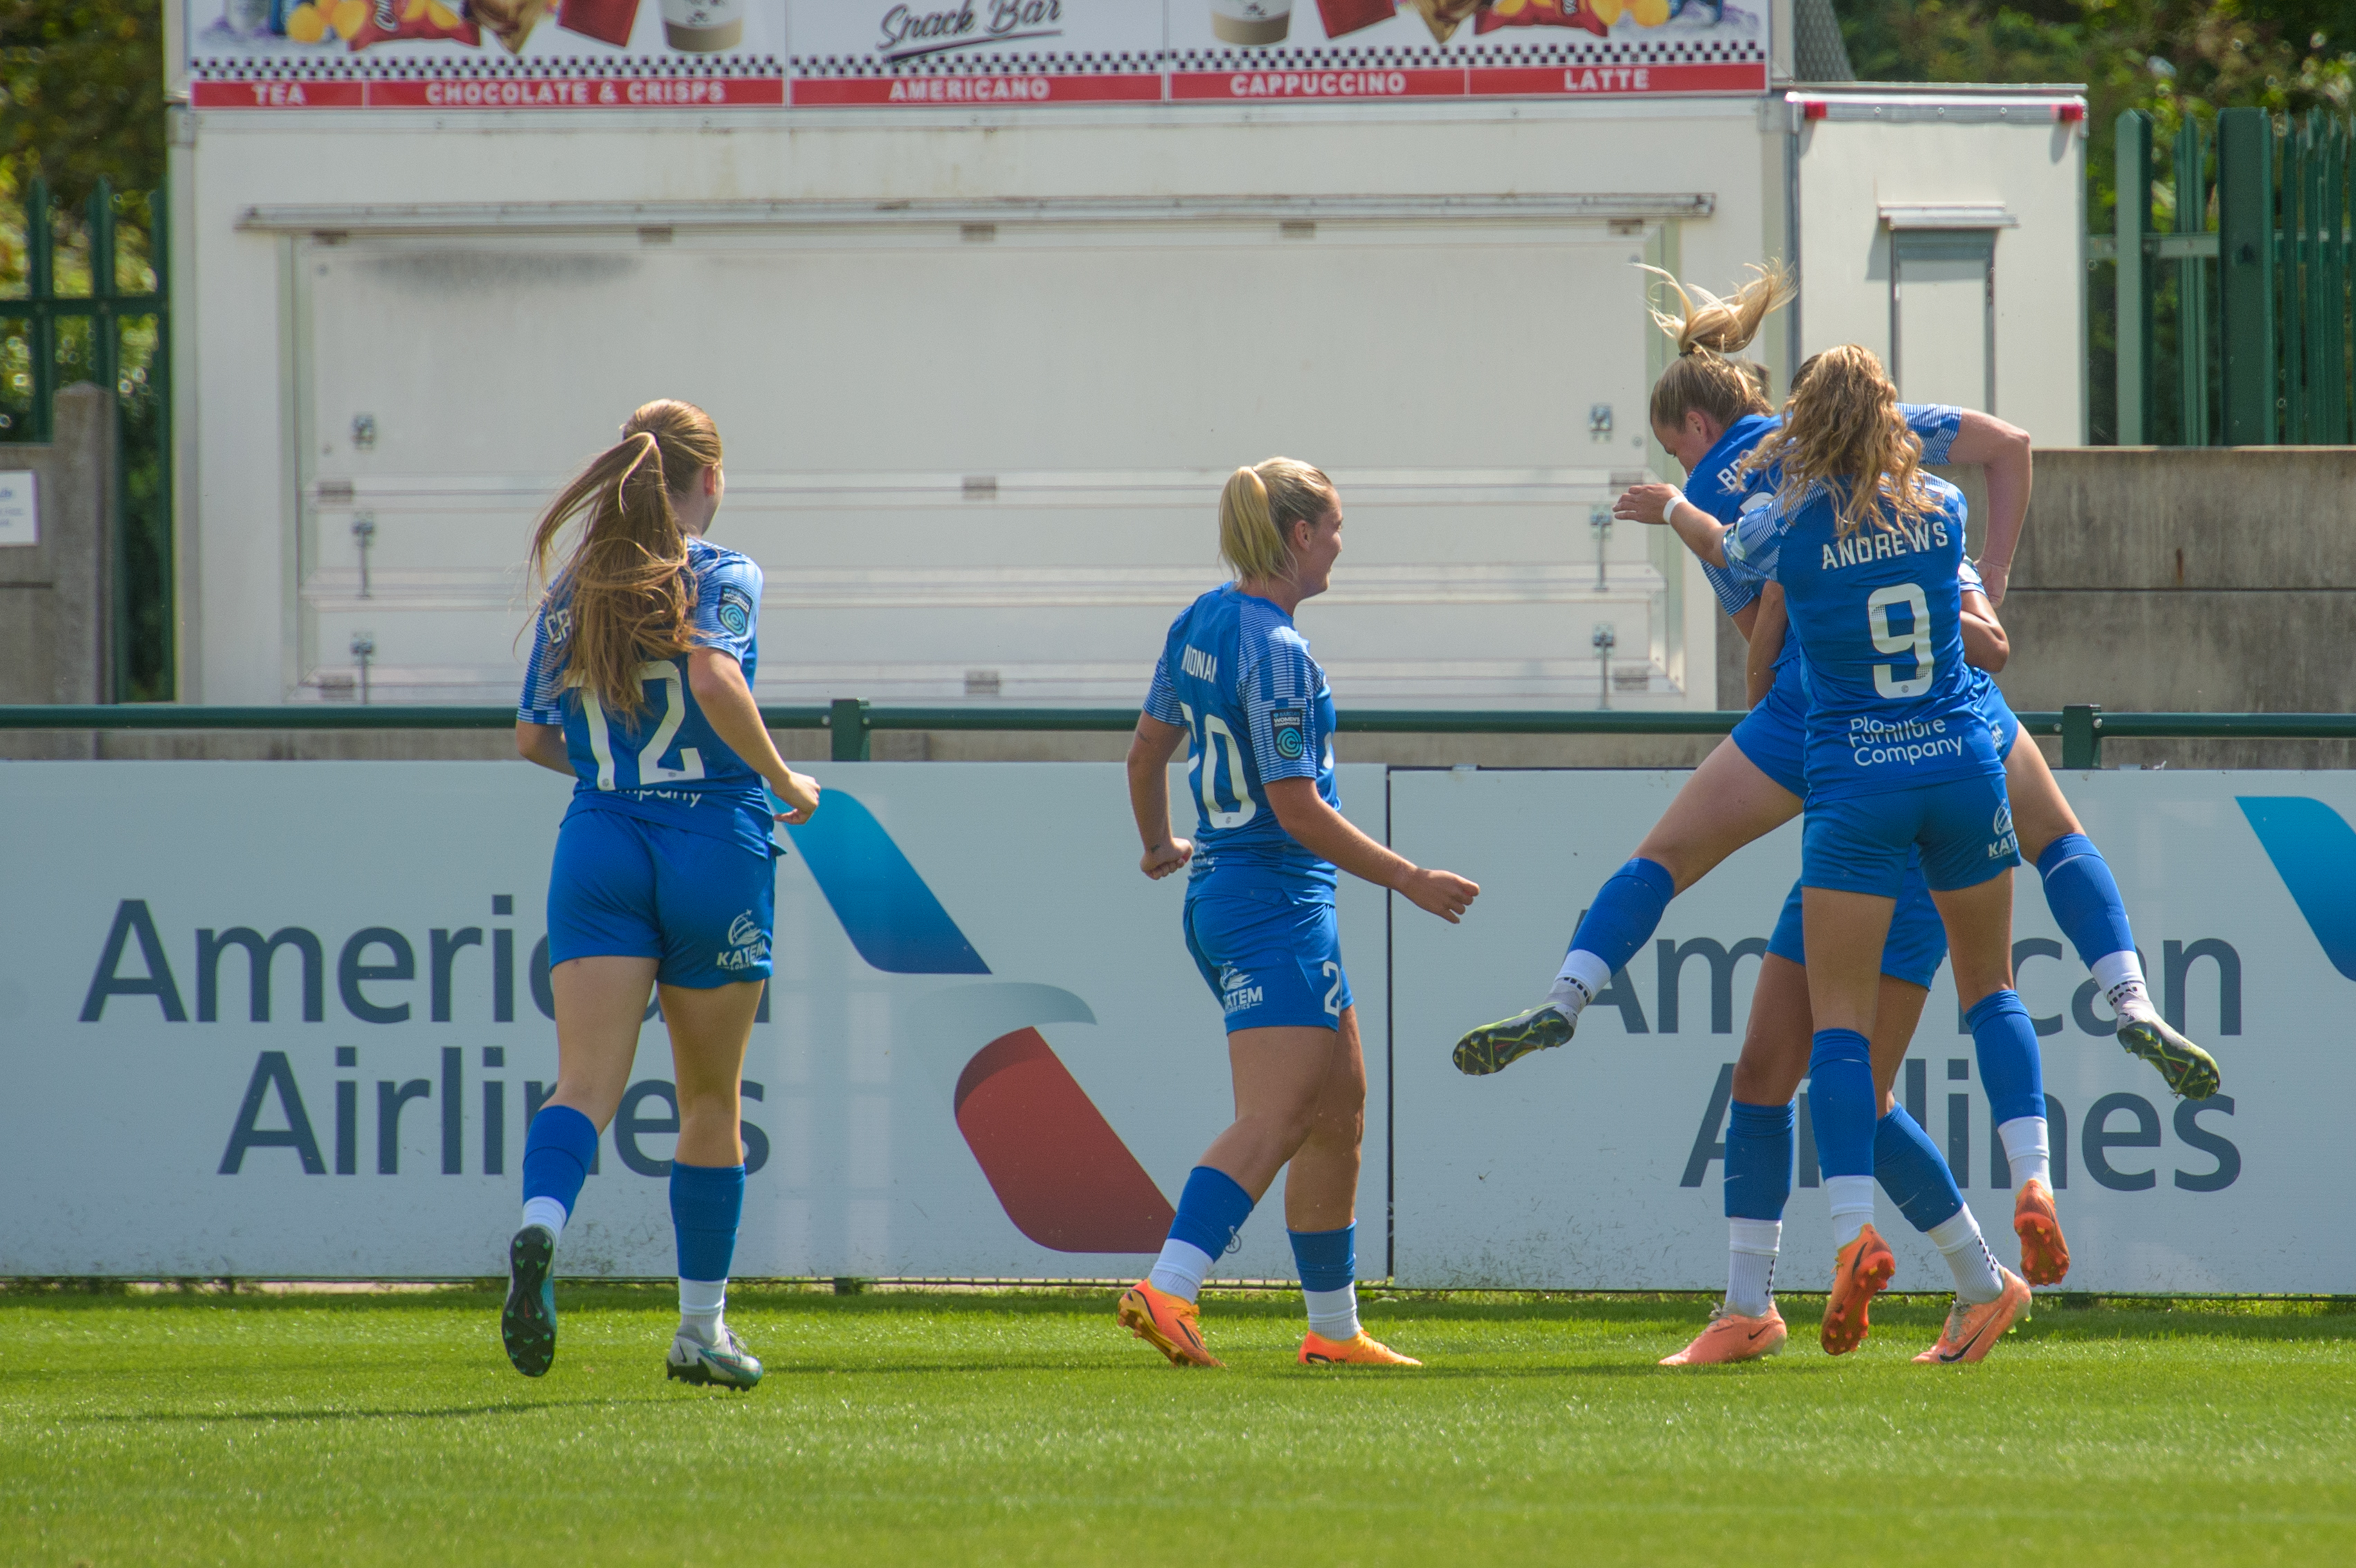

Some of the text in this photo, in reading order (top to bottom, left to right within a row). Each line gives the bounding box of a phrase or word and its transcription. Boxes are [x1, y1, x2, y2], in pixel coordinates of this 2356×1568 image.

[876, 0, 1062, 49] Snack Bar
[425, 80, 726, 105] CHOCOLATE & CRISPS
[888, 78, 1051, 102] AMERICANO
[1229, 73, 1406, 96] CAPPUCCINO
[1564, 69, 1650, 91] LATTE
[251, 83, 306, 105] TEA
[1822, 521, 1948, 570] ANDREWS
[1867, 582, 1934, 700] 9
[1854, 736, 1961, 766] Company
[1988, 832, 2017, 857] KAT
[716, 938, 766, 966] KATEM
